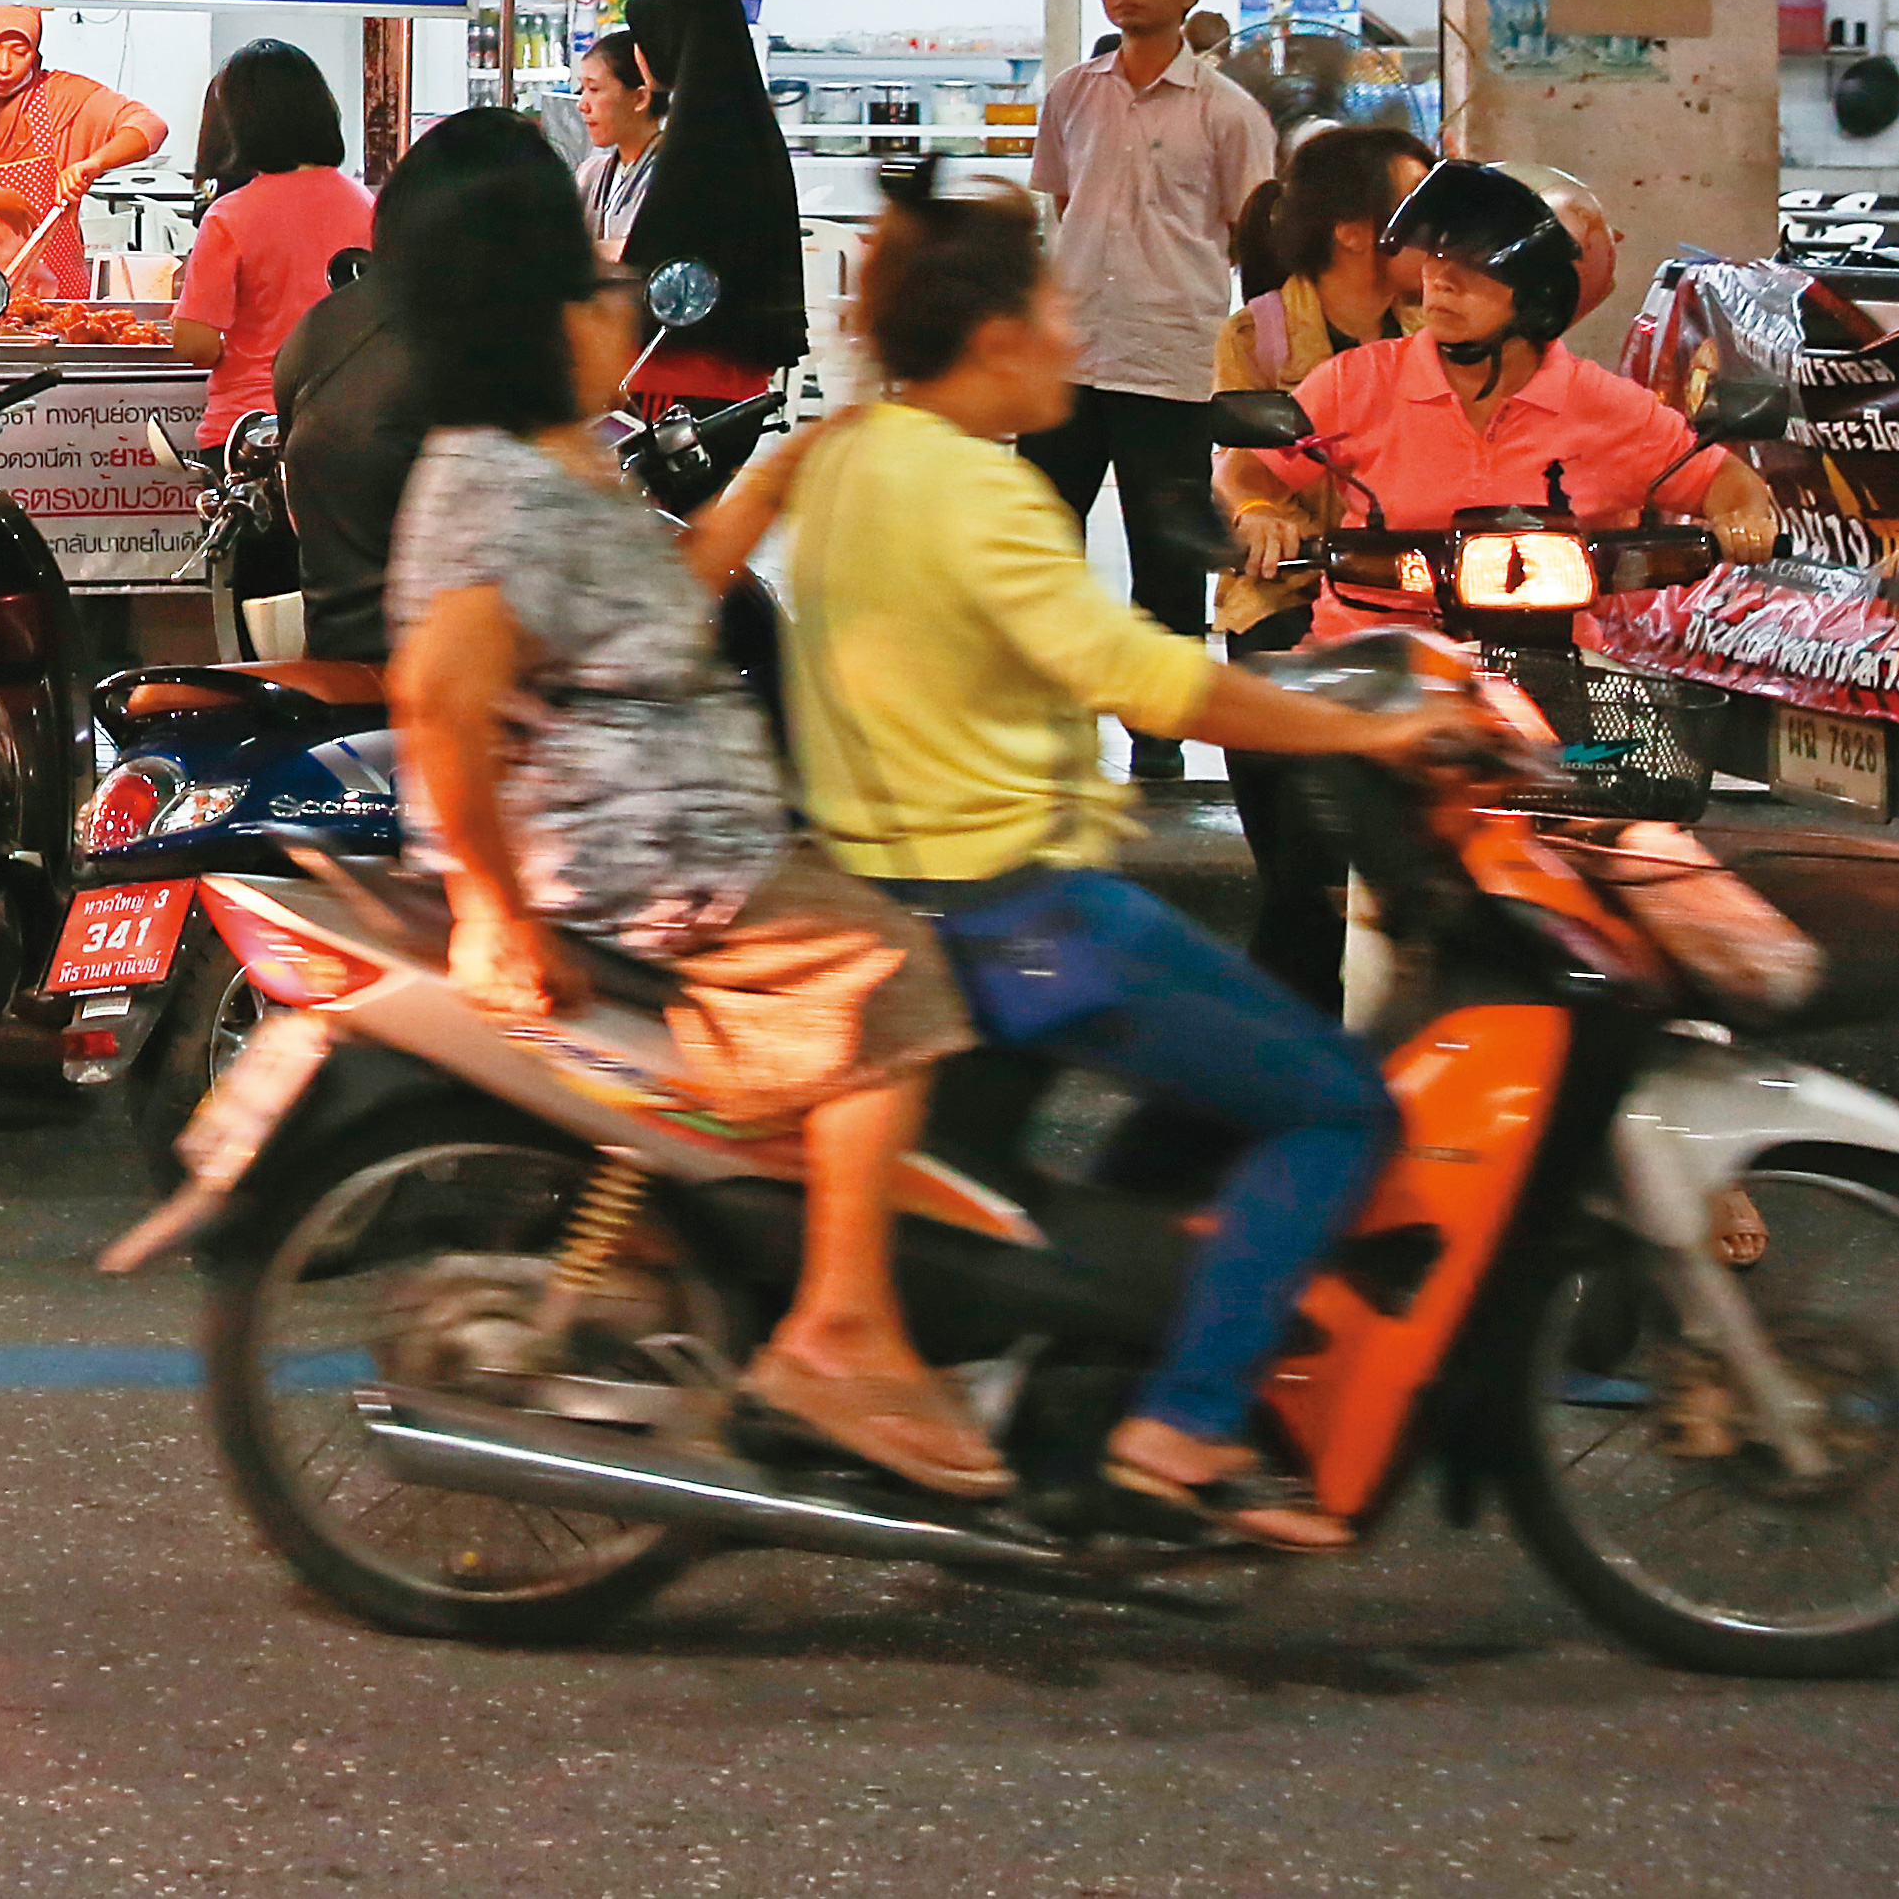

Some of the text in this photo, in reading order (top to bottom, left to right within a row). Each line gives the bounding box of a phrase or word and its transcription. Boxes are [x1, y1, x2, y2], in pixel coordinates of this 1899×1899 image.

[83, 888, 171, 916] หาดใหญ่ 3
[82, 916, 153, 954] 341
